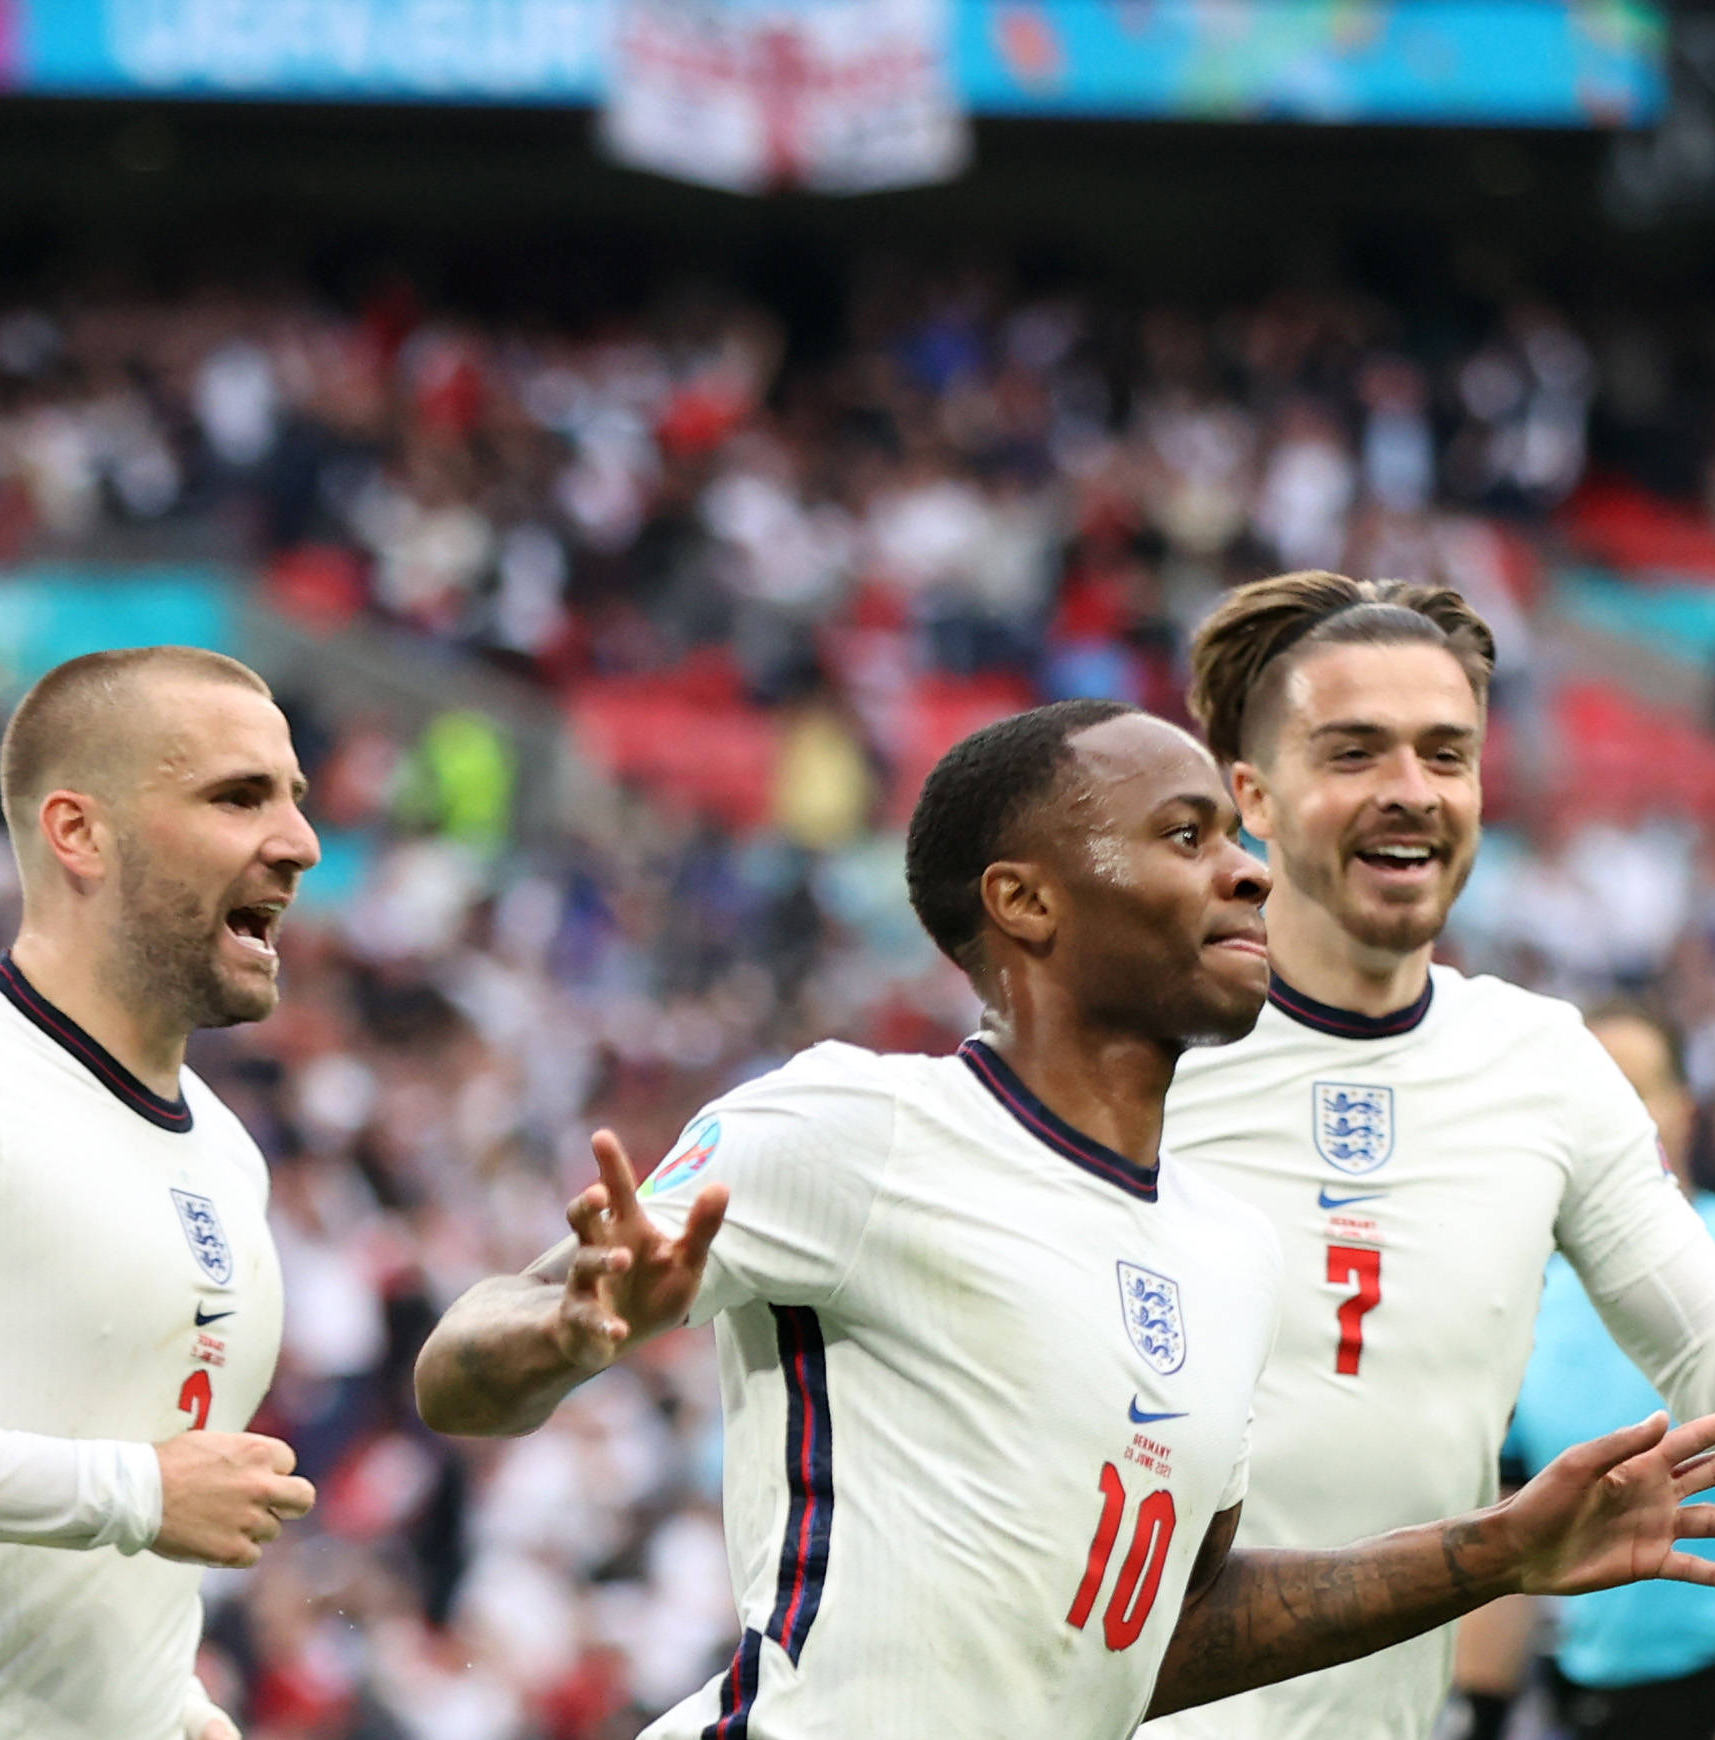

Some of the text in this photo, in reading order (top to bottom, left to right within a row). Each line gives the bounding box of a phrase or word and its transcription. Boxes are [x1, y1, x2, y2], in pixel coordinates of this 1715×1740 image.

[1325, 1245, 1382, 1377] 7
[1133, 1432, 1171, 1461] GERMANY
[1065, 1461, 1177, 1652] 10
